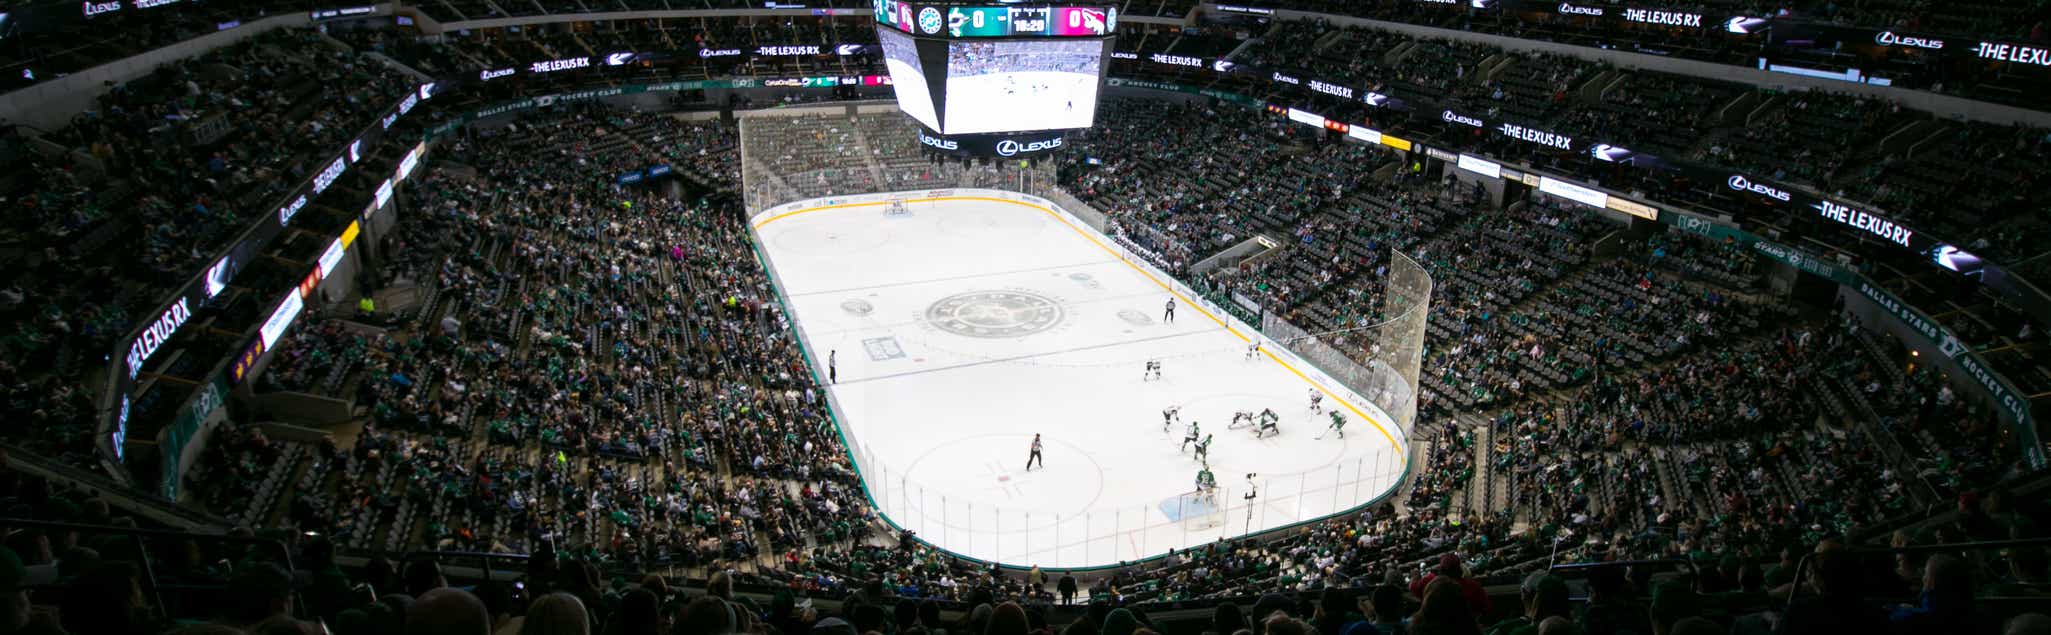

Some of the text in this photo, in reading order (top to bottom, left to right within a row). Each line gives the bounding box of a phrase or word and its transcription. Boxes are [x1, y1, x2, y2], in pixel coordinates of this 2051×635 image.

[972, 10, 985, 28] 0
[1069, 10, 1081, 28] 0
[1570, 7, 1603, 16] LEXUS
[1626, 8, 1702, 28] THE LEXUS RX
[1894, 35, 1944, 49] LEXUS
[710, 48, 741, 57] LEXUS
[760, 45, 820, 56] THE LEXUS RX
[1111, 52, 1138, 60] LEXUS
[1978, 41, 2010, 61] THE
[532, 57, 590, 73] THE LEXUS RX
[1153, 54, 1202, 67] THE LEXUS RX
[489, 68, 516, 79] LEXUS
[1278, 75, 1299, 85] LEXUS
[1310, 80, 1353, 99] THE LEXUS RX
[1453, 115, 1483, 128] LEXUS
[920, 134, 958, 150] LEXUS
[1019, 137, 1062, 152] LEXUS
[1503, 123, 1572, 150] THE LEXUS RX
[1746, 181, 1791, 202] LEXUS
[1821, 200, 1912, 247] THE LEXUS RX
[139, 309, 177, 361] LEXUS
[173, 296, 192, 329] RX
[1861, 283, 1899, 313] DALLAS
[1901, 309, 1937, 339] STARS
[1963, 355, 2004, 396] HOCKEY
